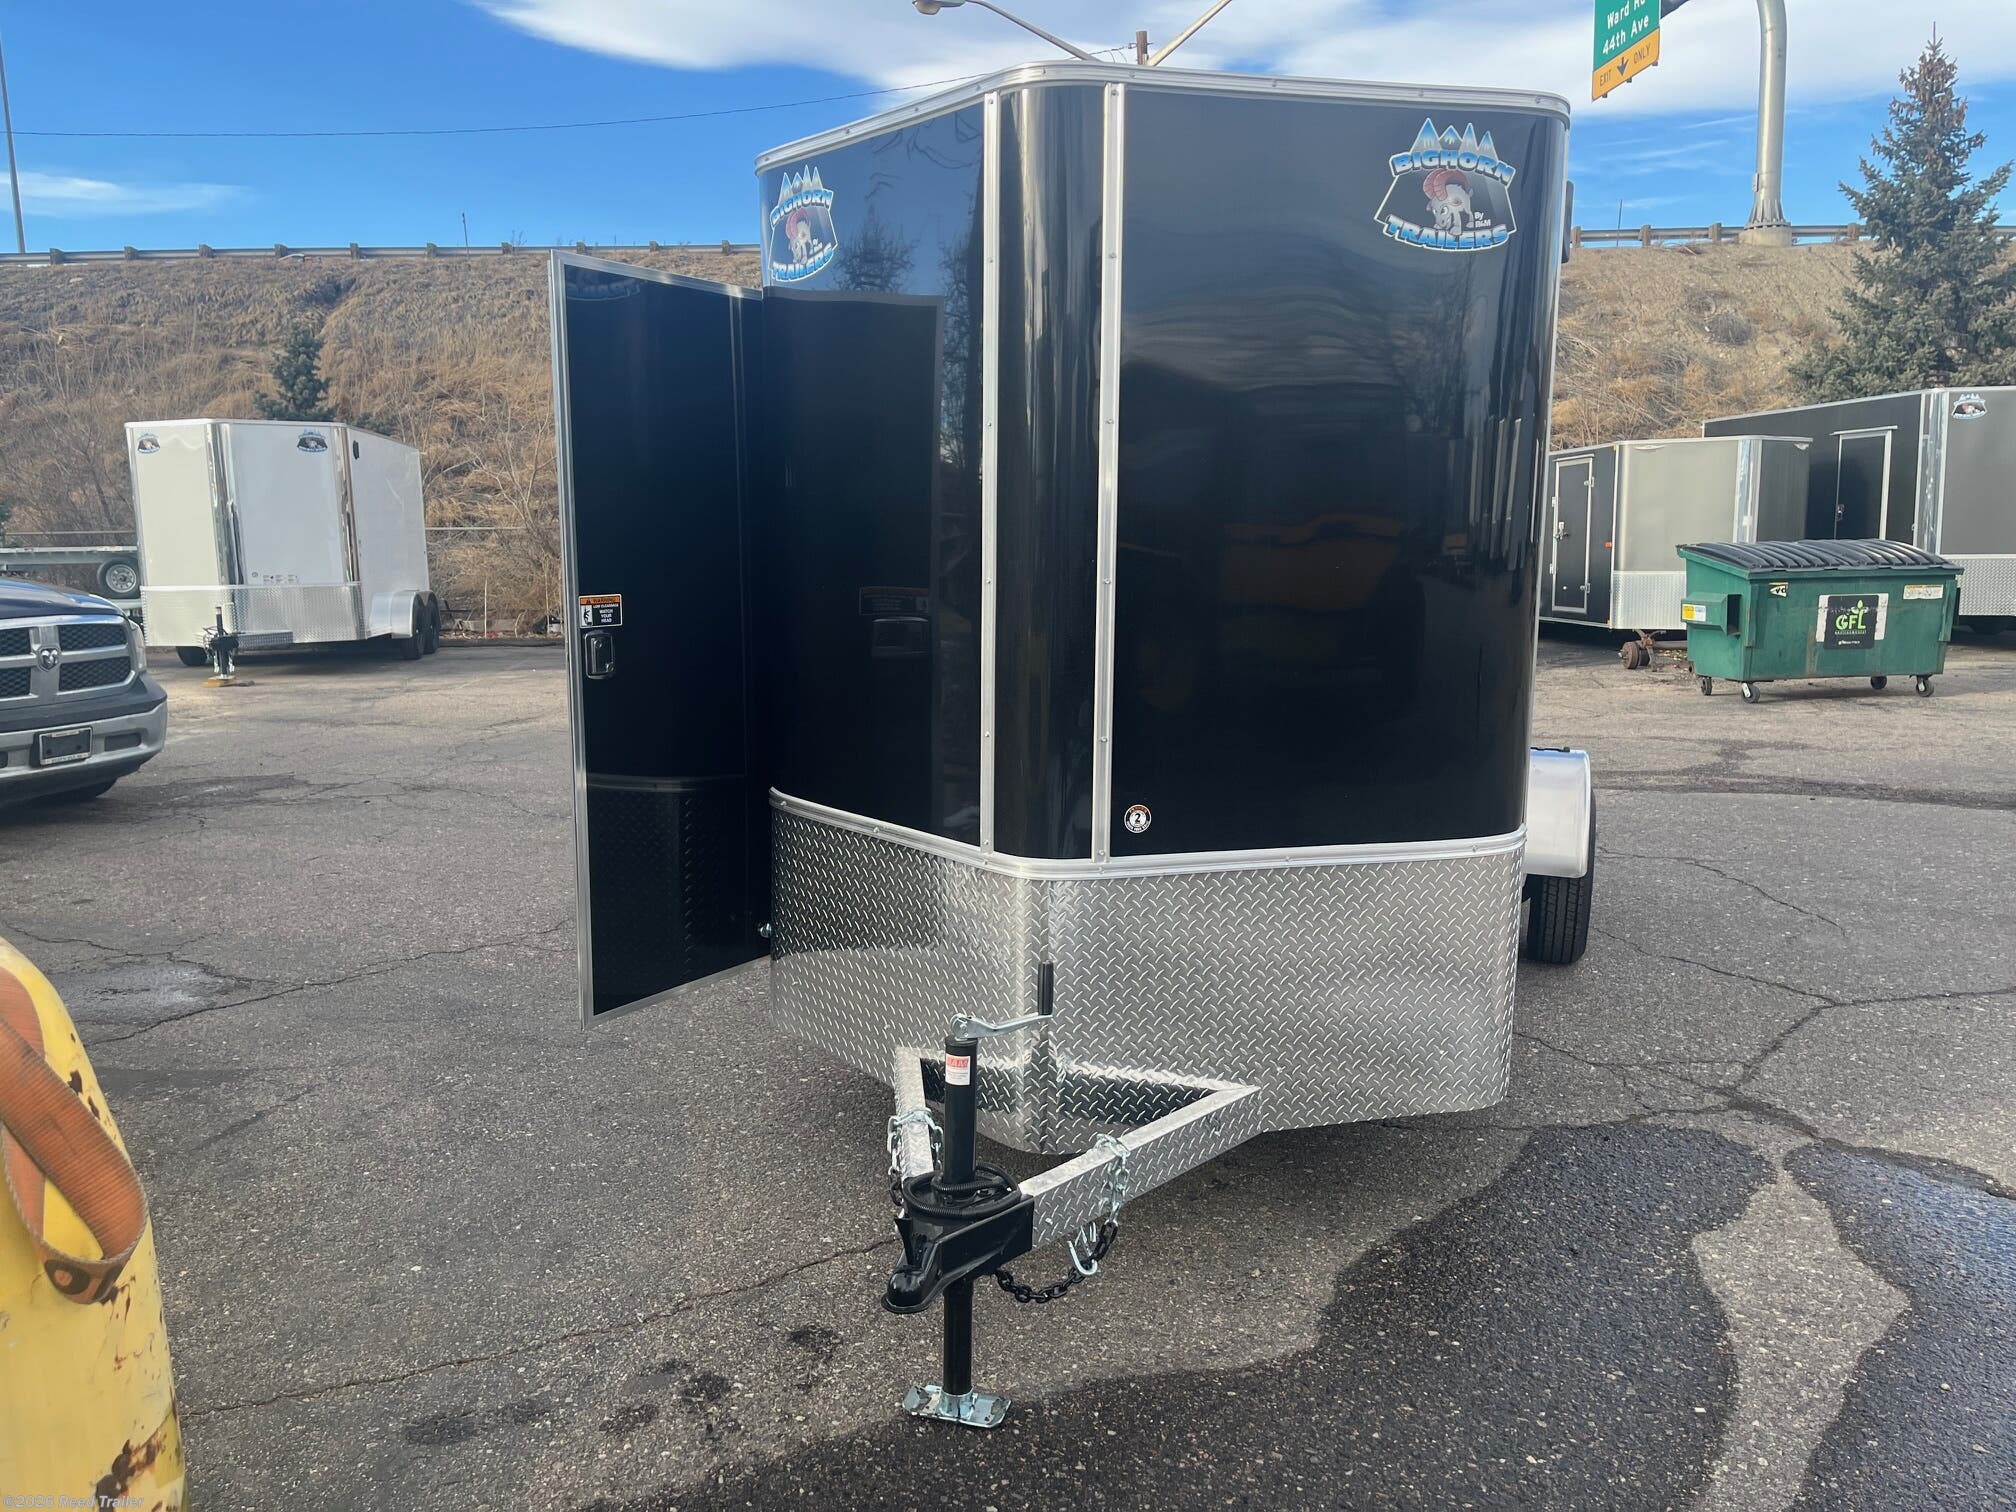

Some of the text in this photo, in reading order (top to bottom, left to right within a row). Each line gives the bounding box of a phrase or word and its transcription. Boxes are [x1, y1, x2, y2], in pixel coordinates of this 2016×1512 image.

[1607, 0, 1630, 29] Ward
[1602, 15, 1649, 55] 44th Ave
[1600, 43, 1651, 87] EXIT ONLY
[1392, 150, 1514, 185] BIGHORN
[770, 190, 833, 225] BIGHORN
[1474, 211, 1484, 220] By
[1386, 213, 1509, 249] TRAILERS
[772, 242, 834, 280] TRAILERS
[1835, 609, 1866, 630] GFL
[1134, 812, 1142, 822] 2
